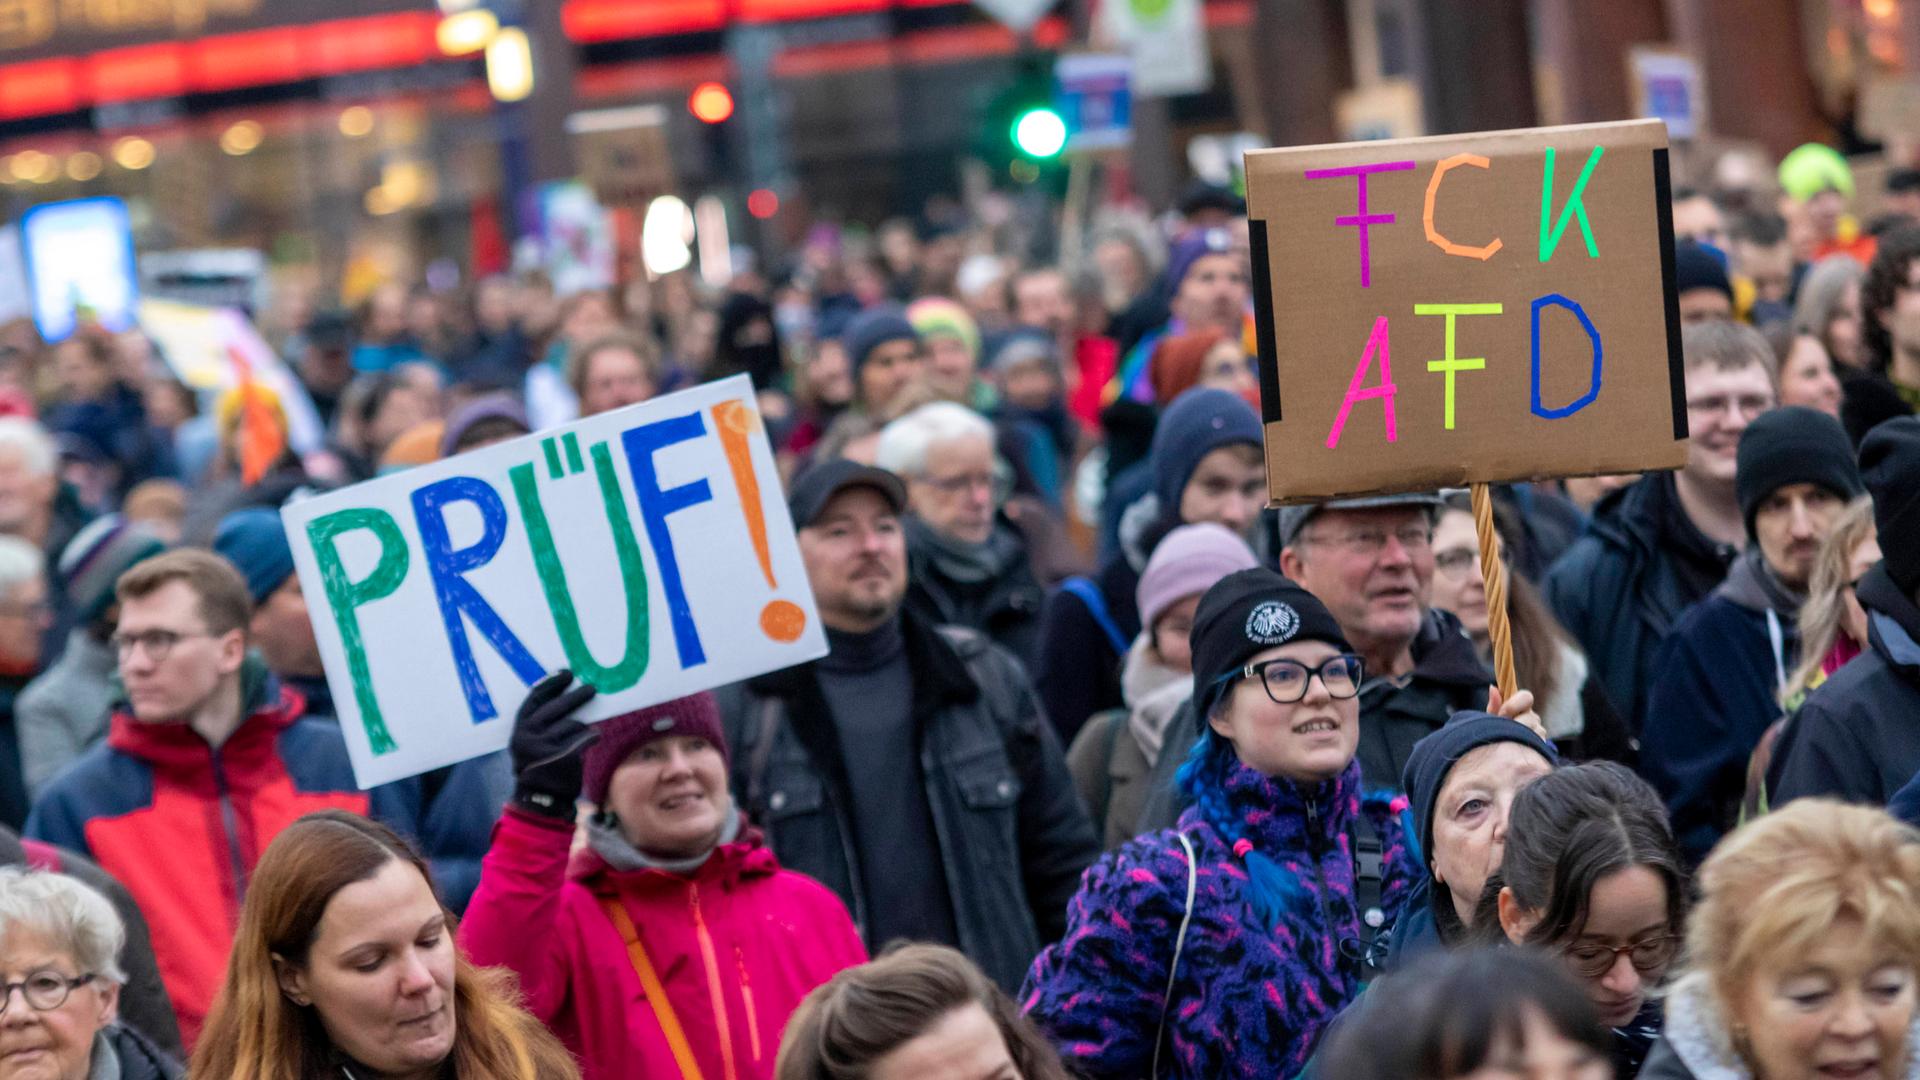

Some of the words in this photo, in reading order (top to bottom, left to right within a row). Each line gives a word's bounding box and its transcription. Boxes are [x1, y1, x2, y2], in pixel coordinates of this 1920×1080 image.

[1305, 146, 1604, 287] FCK
[1326, 293, 1603, 449] AFD
[305, 399, 807, 757] PRÜF!
